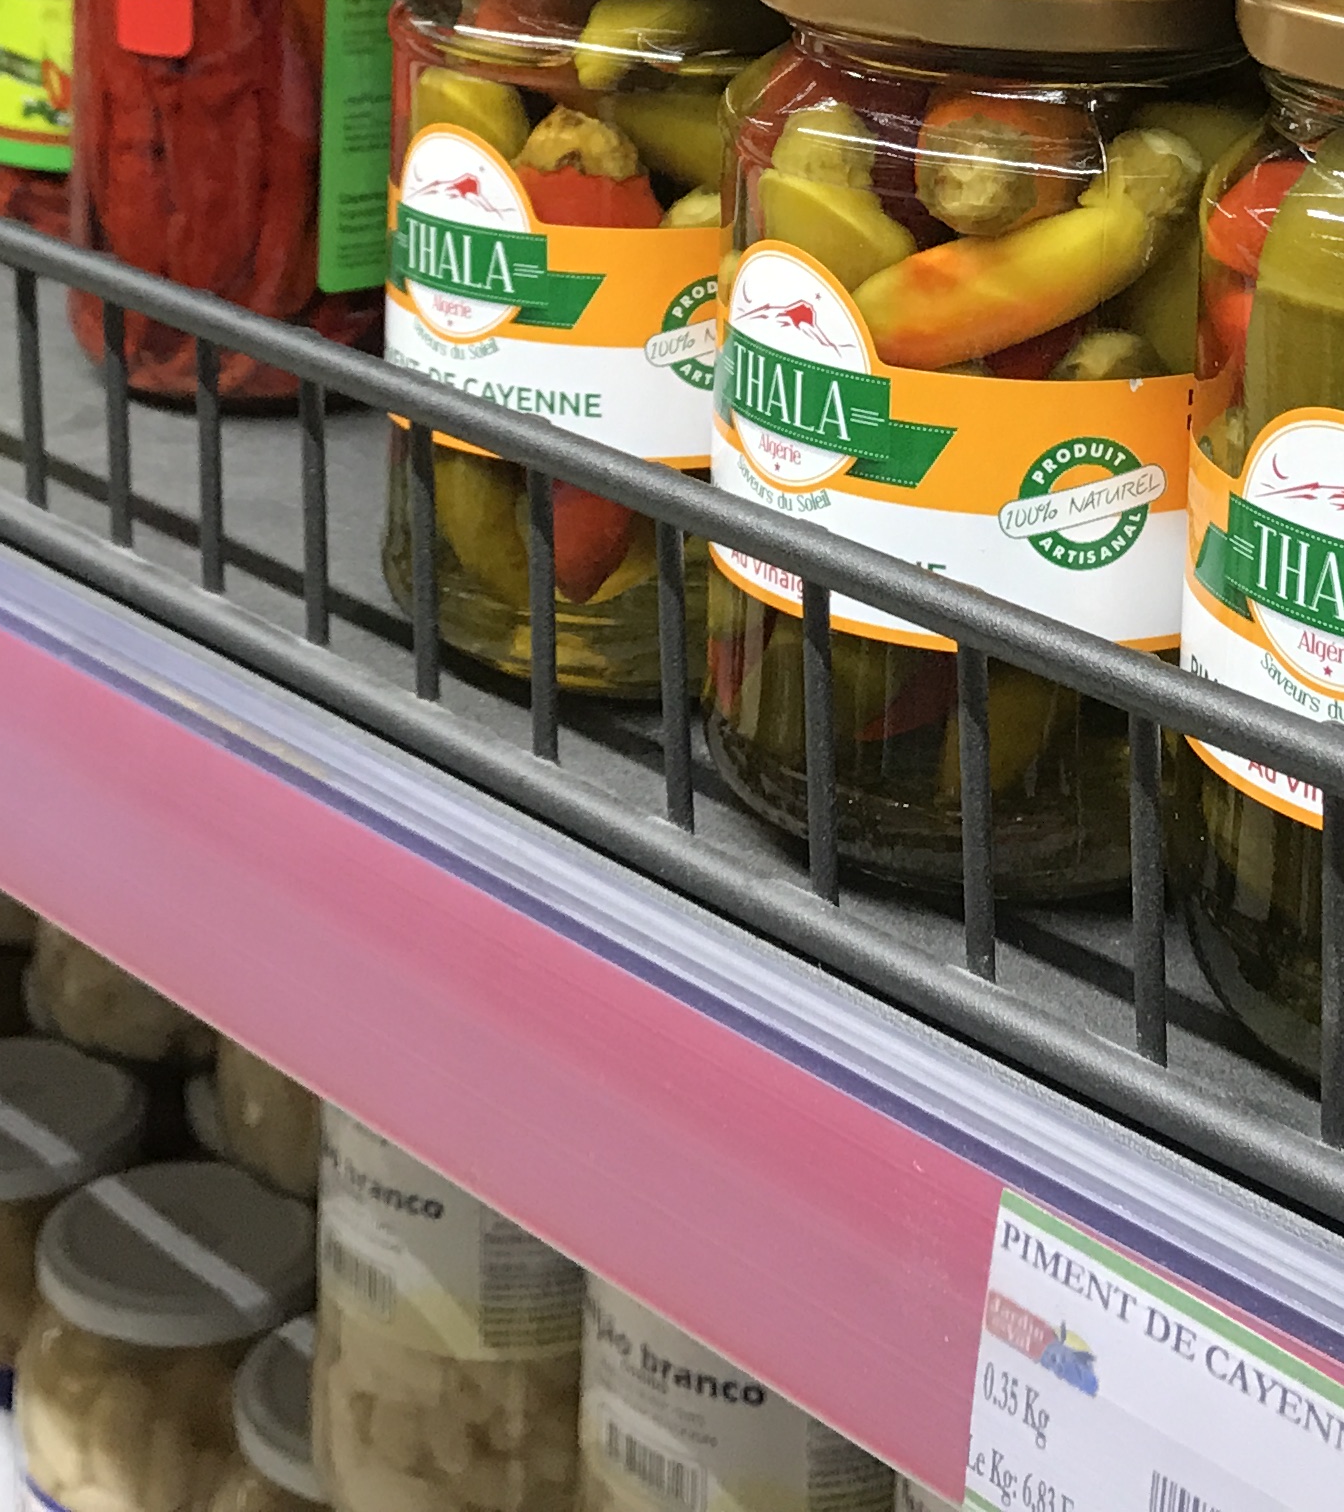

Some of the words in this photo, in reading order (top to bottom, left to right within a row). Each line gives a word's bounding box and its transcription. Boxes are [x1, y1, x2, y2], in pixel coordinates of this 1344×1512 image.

[406, 217, 516, 294] THALA
[450, 345, 466, 360] du
[650, 331, 695, 360] 100%
[462, 378, 602, 418] CAYENNE
[733, 340, 851, 441] THALA
[759, 433, 801, 466] Algérie
[1032, 443, 1126, 485] PRODUIT
[777, 494, 793, 512] du
[796, 489, 832, 512] Soleil
[1006, 500, 1058, 530] 100%
[1069, 473, 1161, 515] NATUREL
[1039, 512, 1141, 564] ARTISANAL
[1260, 652, 1320, 713] Saveurs
[1001, 1220, 1137, 1322] PIMENT
[1144, 1310, 1197, 1361] DE
[640, 1343, 765, 1407] branco
[983, 1361, 1018, 1416] 0.35
[1022, 1385, 1050, 1450] Kg
[989, 1448, 1018, 1507] Kg:
